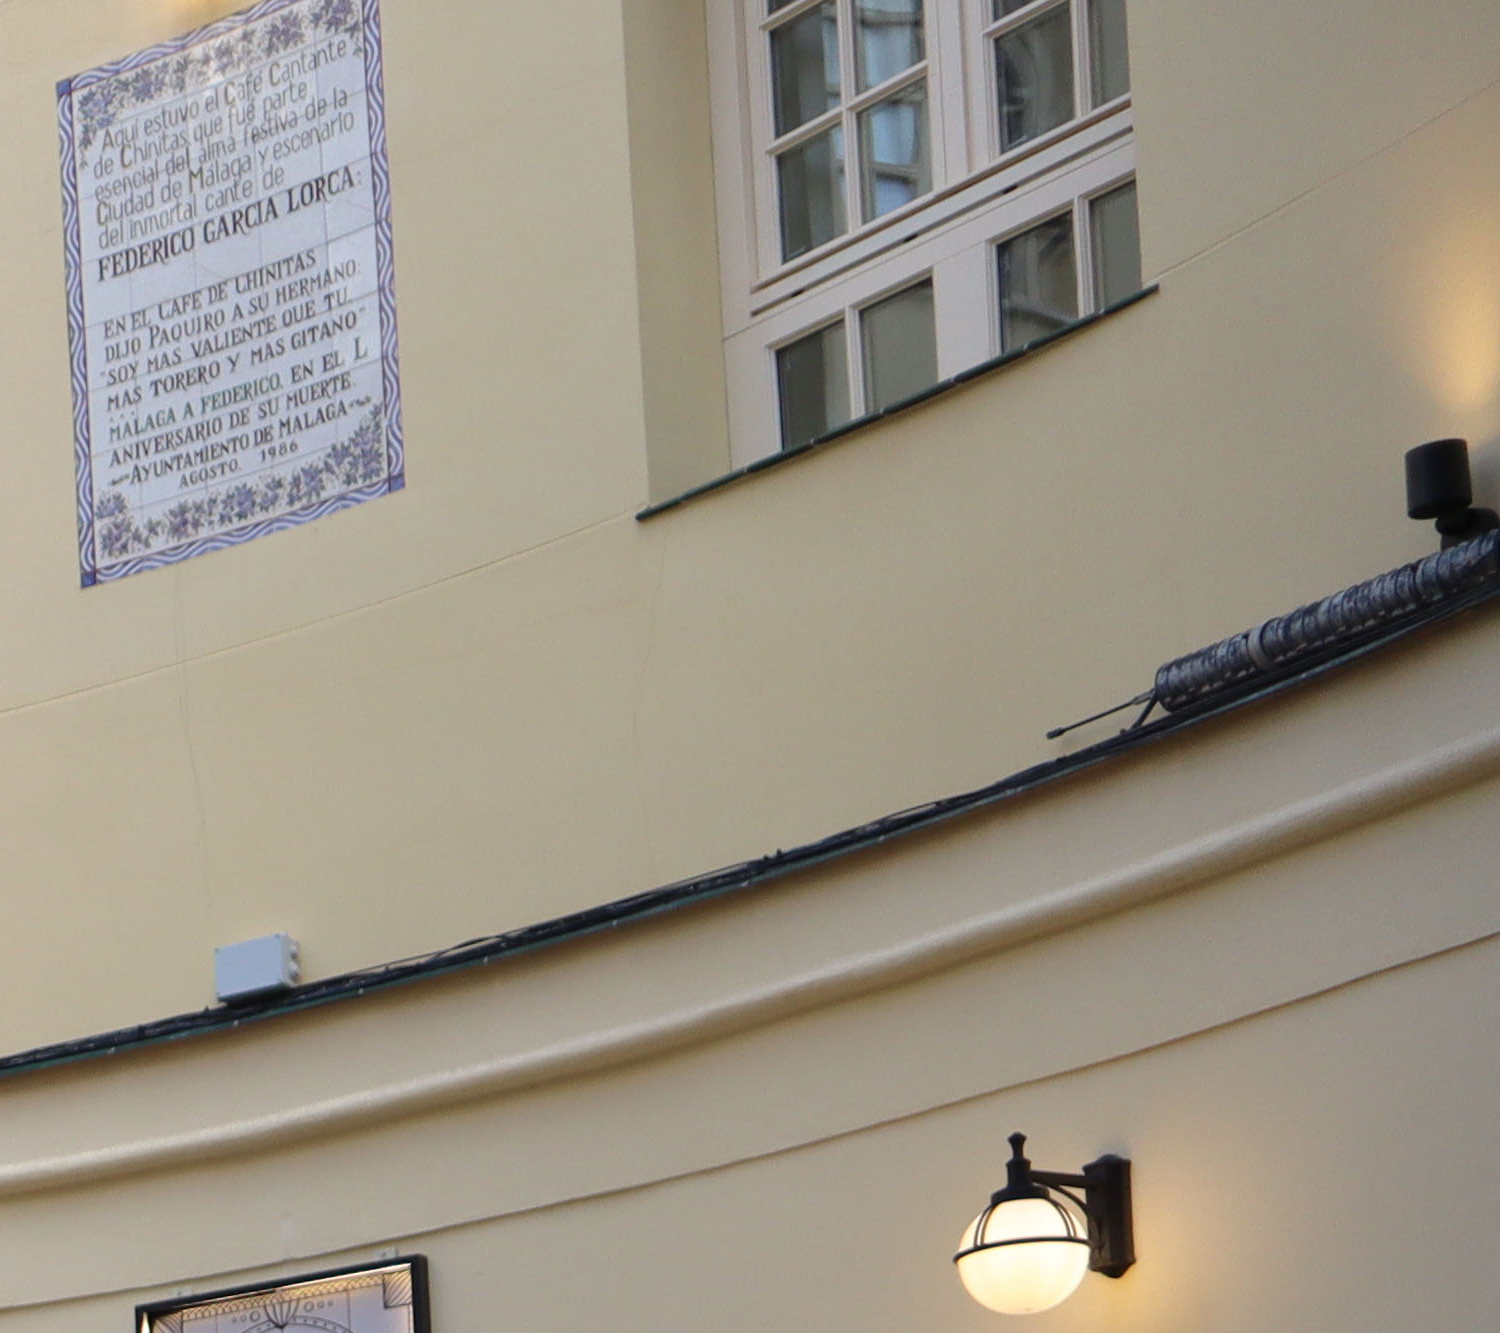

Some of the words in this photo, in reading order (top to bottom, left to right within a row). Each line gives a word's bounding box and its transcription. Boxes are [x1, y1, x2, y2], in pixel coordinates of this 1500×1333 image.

[144, 100, 199, 136] estuvo
[205, 89, 219, 117] el
[269, 39, 346, 86] Cantante
[94, 157, 113, 179] de
[120, 132, 189, 169] Chinitas
[194, 114, 223, 143] que
[264, 82, 307, 118] parte
[95, 162, 159, 203] esencial
[199, 139, 235, 164] alma
[244, 113, 298, 145] festiva
[305, 96, 327, 121] de
[96, 189, 155, 226] Ciudad
[161, 180, 182, 202] de
[273, 112, 354, 161] escenario
[98, 227, 195, 282] FEDERICO
[204, 198, 279, 244] GARCIA
[99, 221, 124, 250] del
[130, 194, 196, 241] inmortal
[205, 180, 253, 212] cante
[263, 165, 284, 190] de
[104, 320, 125, 340] EN
[132, 311, 150, 332] EL
[158, 294, 201, 322] CAFE
[208, 282, 228, 304] DE
[235, 249, 316, 294] CHINITAS
[105, 337, 141, 364] DIJO
[150, 310, 225, 349] PAQUIRO
[250, 293, 269, 315] SU
[108, 386, 142, 412] MAS
[150, 361, 221, 398] TORERO
[251, 338, 285, 367] MAS
[147, 350, 181, 375] MAS
[191, 317, 277, 358] VALIENTE
[282, 300, 316, 327] QUE
[109, 407, 176, 444] MALAGA
[291, 362, 313, 385] EN
[322, 351, 344, 373] EL
[109, 417, 223, 467] ANIVERSARIO
[229, 406, 250, 430] DE
[258, 397, 279, 419] SU
[130, 433, 250, 485] AYUNTAMIENTO
[254, 425, 273, 447] DE
[279, 400, 348, 437] MALAGA
[261, 440, 298, 463] 1986
